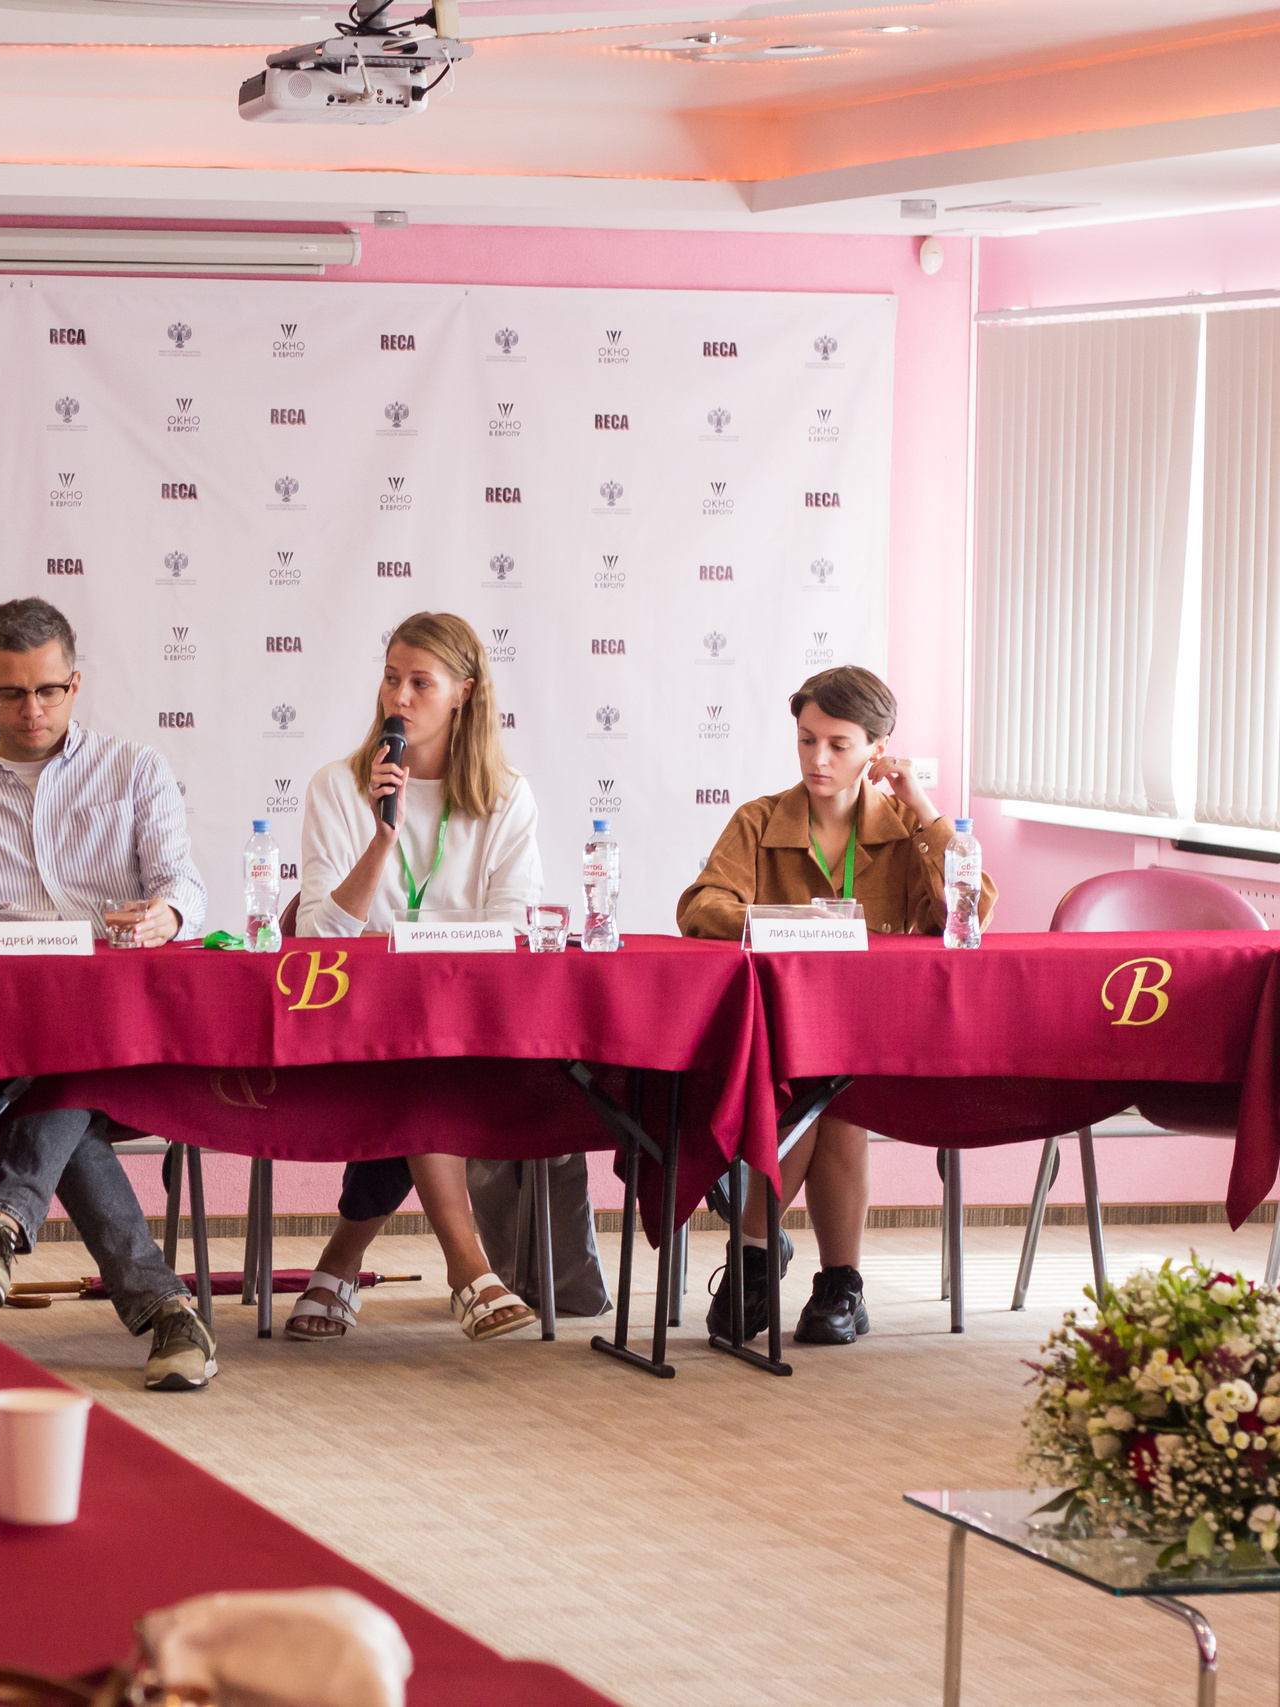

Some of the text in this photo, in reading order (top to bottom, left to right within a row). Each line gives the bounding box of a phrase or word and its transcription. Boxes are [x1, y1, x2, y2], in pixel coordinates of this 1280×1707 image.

[50, 329, 87, 346] RECA
[381, 335, 416, 351] RECA
[273, 342, 305, 350] ОКНО
[598, 348, 629, 357] ОКНО
[703, 342, 738, 358] RECA
[168, 416, 200, 425] ОКНО
[271, 409, 307, 426] RECA
[595, 414, 629, 430] RECA
[489, 420, 521, 429] ОКНО
[809, 426, 839, 435] ОКНО
[50, 491, 82, 499] ОКНО
[162, 484, 198, 500] RECA
[380, 494, 412, 503] ОКНО
[486, 487, 522, 504] RECA
[703, 499, 734, 508] ОКНО
[805, 493, 840, 508] RECA
[47, 559, 84, 575] RECA
[269, 569, 301, 578] ОКНО
[378, 562, 412, 578] RECA
[700, 566, 734, 581] RECA
[595, 573, 626, 581] ОКНО
[164, 645, 196, 653] ОКНО
[267, 637, 303, 653] RECA
[592, 639, 626, 655] RECA
[159, 712, 195, 729] RECA
[499, 713, 516, 729] CA
[699, 723, 730, 732] ОКНО
[267, 797, 298, 805] ОКНО
[590, 797, 621, 806] ОКНО
[696, 789, 730, 805] RECA
[280, 864, 298, 879] CA
[37, 935, 78, 946] ЖИВОЙ
[411, 929, 503, 940] ИРИНА ОБИДОВА
[769, 929, 855, 939] ЛИЗА ЦЫГАНОВА
